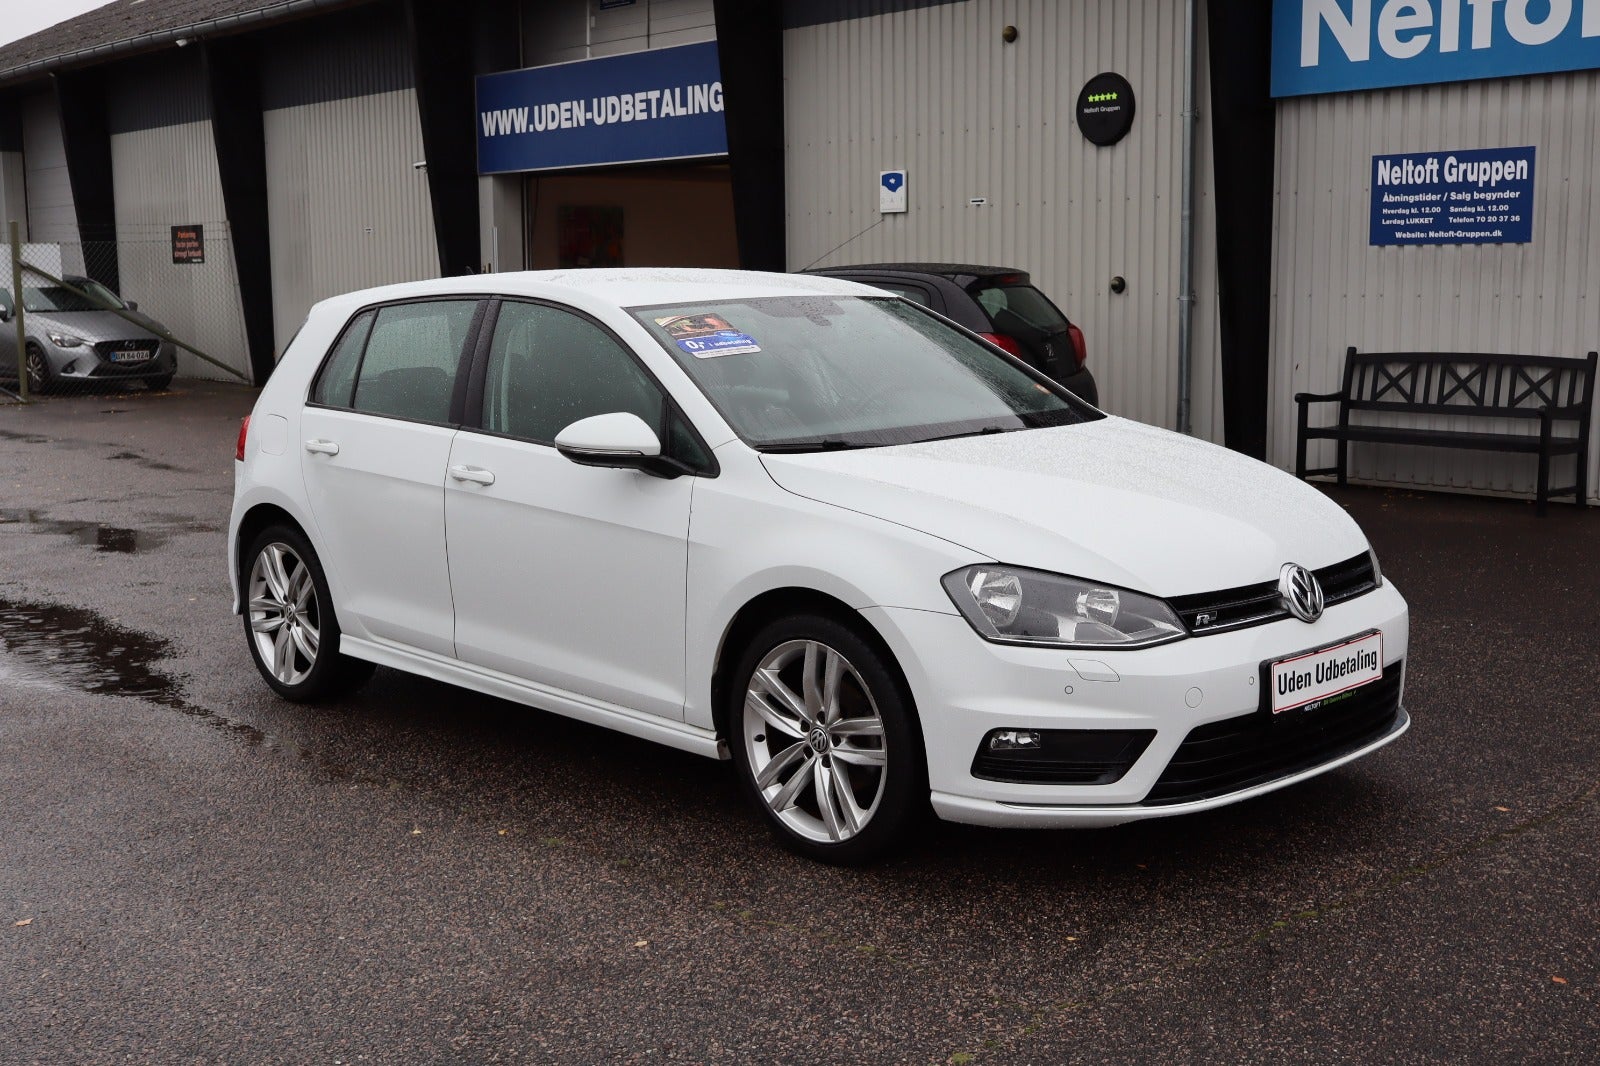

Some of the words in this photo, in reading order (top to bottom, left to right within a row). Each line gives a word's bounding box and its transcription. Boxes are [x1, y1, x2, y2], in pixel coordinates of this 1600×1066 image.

[481, 81, 724, 137] WWW.UDEN-UDBETALING
[1378, 158, 1439, 186] Neltoft
[1444, 156, 1528, 187] Gruppen
[1383, 192, 1441, 203] Åbningstider
[1450, 191, 1471, 201] Salg
[1473, 190, 1520, 201] begynder
[1382, 207, 1410, 215] Hverdag
[1449, 205, 1475, 213] Søndag
[1487, 204, 1509, 212] 12.00
[1428, 230, 1502, 238] Neltoft-Gruppen.dk
[1278, 671, 1311, 695] Uden
[1316, 650, 1377, 684] Udbetaling
